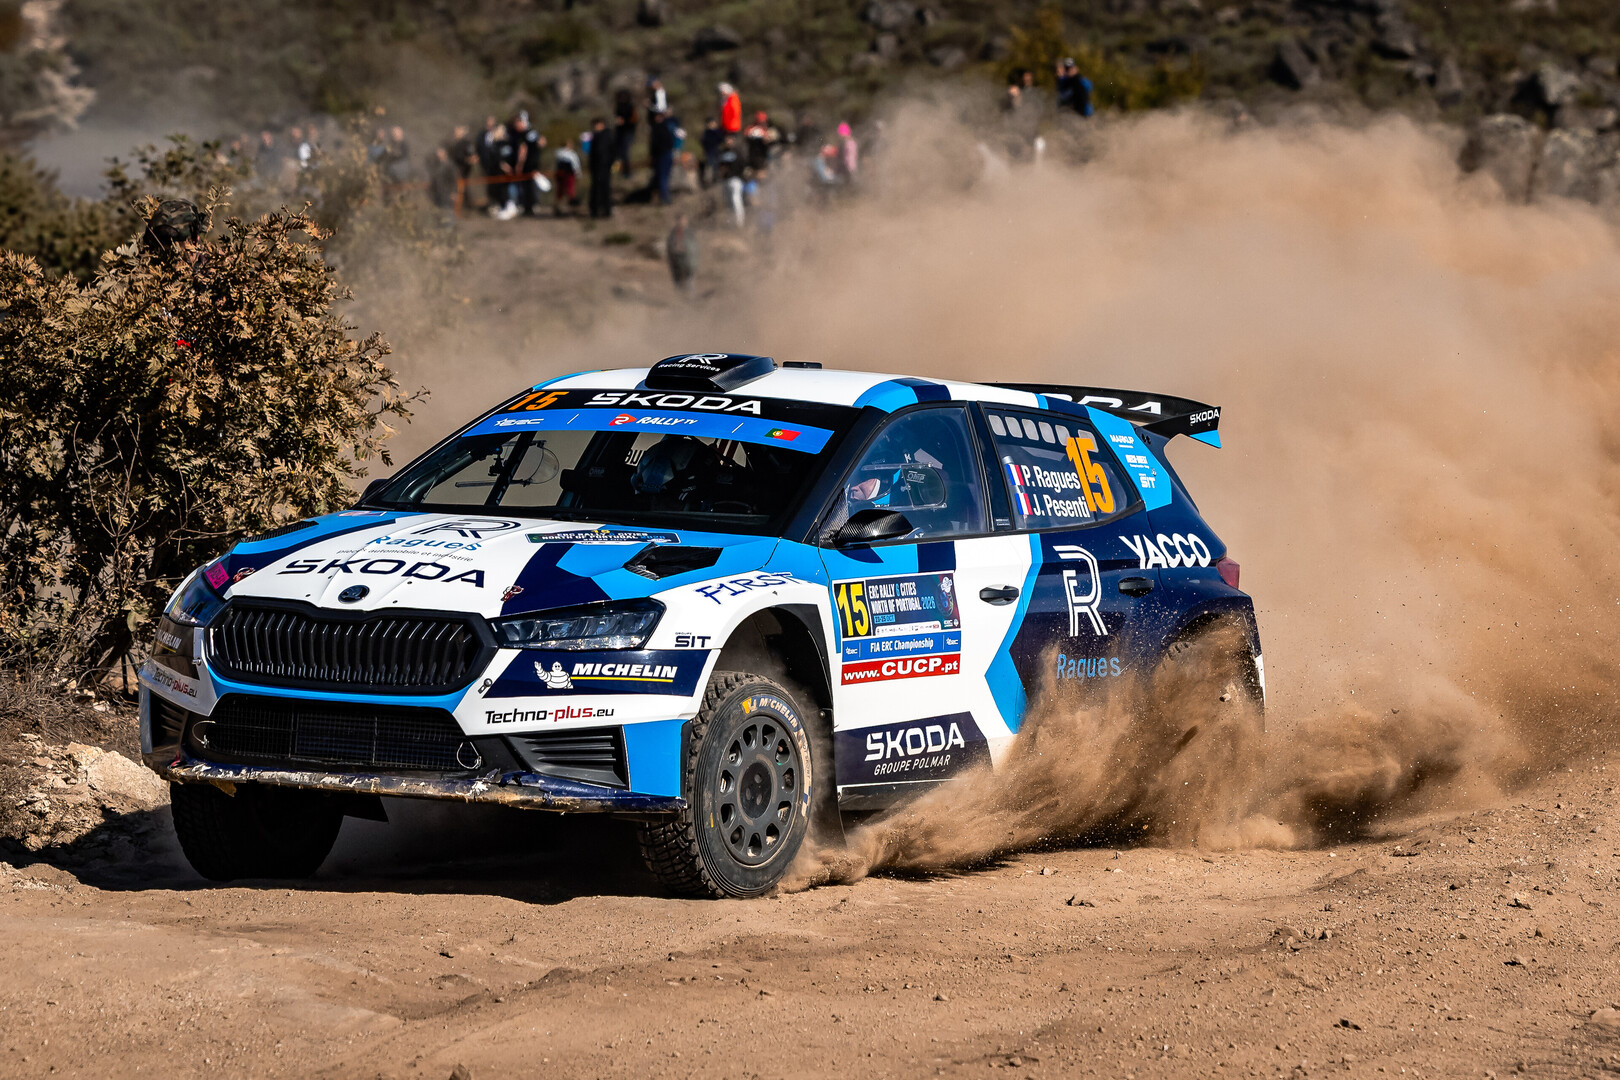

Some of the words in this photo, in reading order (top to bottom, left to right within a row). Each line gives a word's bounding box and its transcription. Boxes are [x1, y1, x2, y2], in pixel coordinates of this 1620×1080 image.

[686, 363, 721, 372] Services
[508, 392, 570, 410] 15
[1020, 465, 1036, 487] P.
[1032, 466, 1081, 494] Ragues
[1066, 437, 1114, 514] 15
[1140, 476, 1156, 488] SIT
[1033, 494, 1046, 516] J.
[1042, 494, 1090, 518] Pesenti
[366, 536, 482, 551] Ragues
[1118, 533, 1212, 570] YACCO
[868, 584, 879, 599] ERC
[879, 583, 895, 598] RALLY
[900, 582, 917, 596] CITIES
[837, 583, 870, 636] 15
[870, 599, 889, 614] NORTH
[888, 598, 896, 613] OF
[895, 597, 922, 612] PORTUGAL
[674, 636, 711, 648] SIT
[870, 642, 880, 653] FIA
[882, 640, 893, 652] ERC
[894, 638, 934, 651] Championship
[572, 663, 678, 678] MICHELIN
[844, 658, 958, 680] www.CUCP.pt
[1056, 654, 1122, 684] Ragues
[485, 706, 614, 724] Techno-plus.eu
[874, 760, 912, 776] GROUPE
[912, 754, 950, 770] POLMAR
